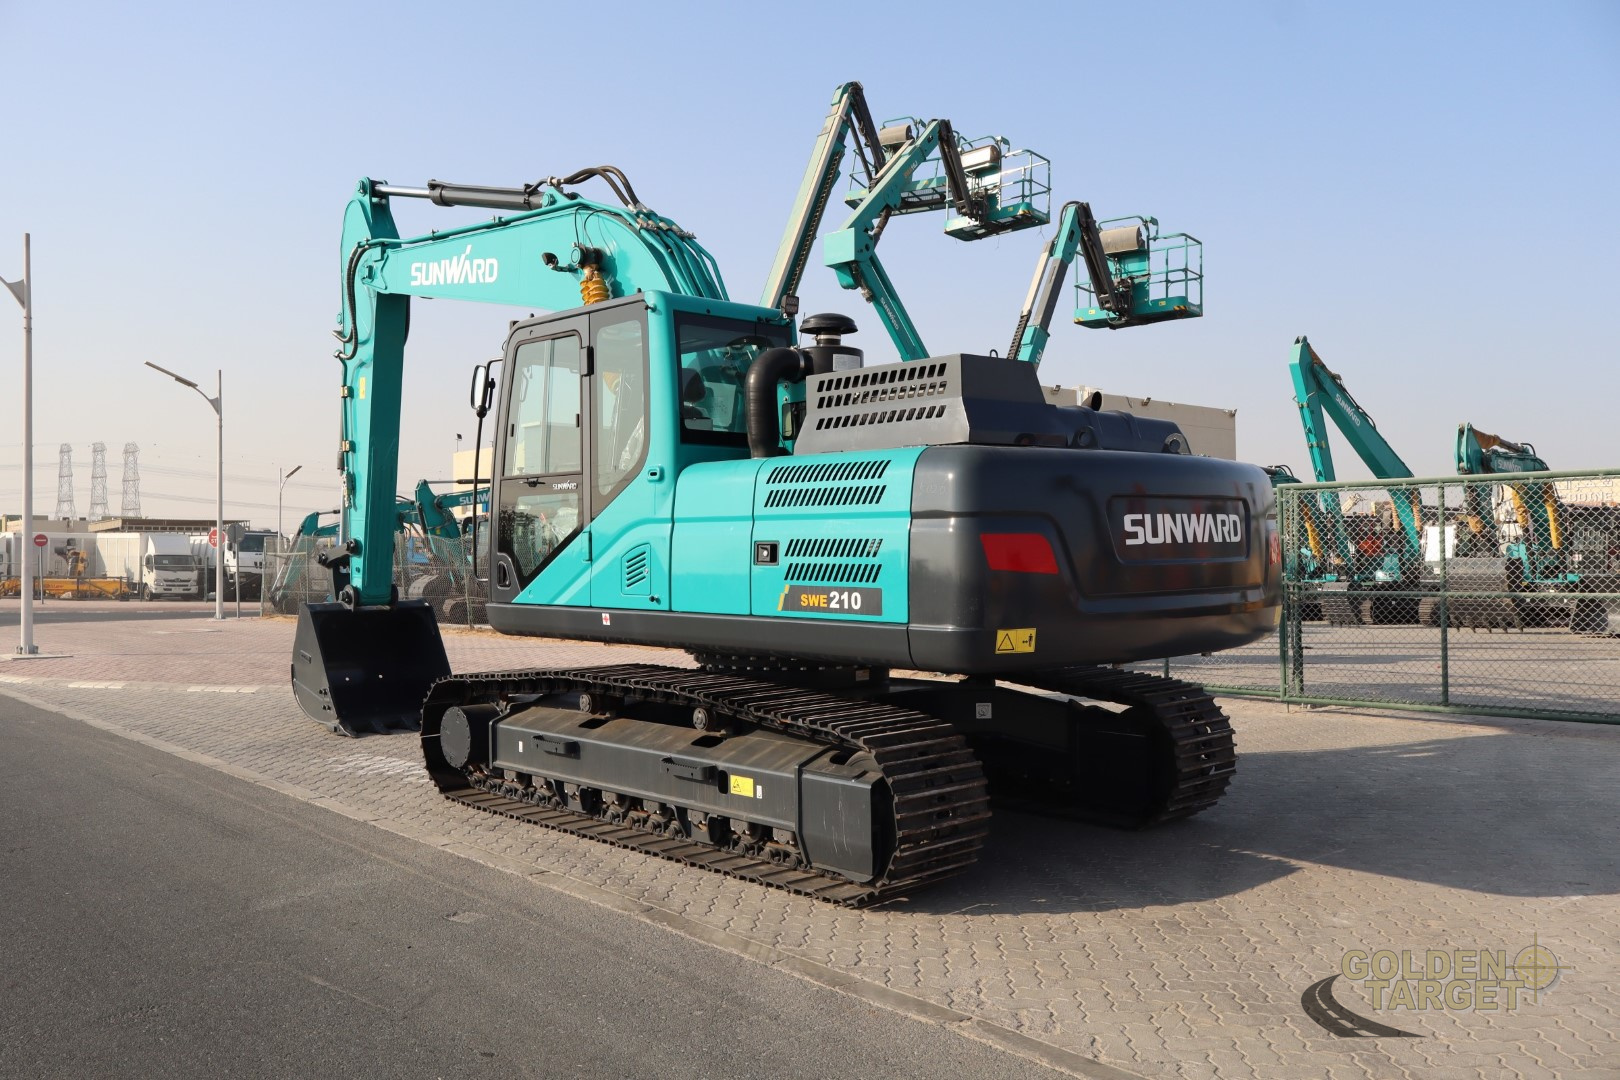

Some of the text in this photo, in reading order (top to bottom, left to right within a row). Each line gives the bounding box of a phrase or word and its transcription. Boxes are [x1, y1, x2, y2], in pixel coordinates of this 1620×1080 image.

[410, 244, 499, 286] SUNWARD
[1335, 393, 1361, 427] SUNWARD
[1123, 513, 1241, 546] SUNWARD
[800, 591, 862, 610] SWE 210
